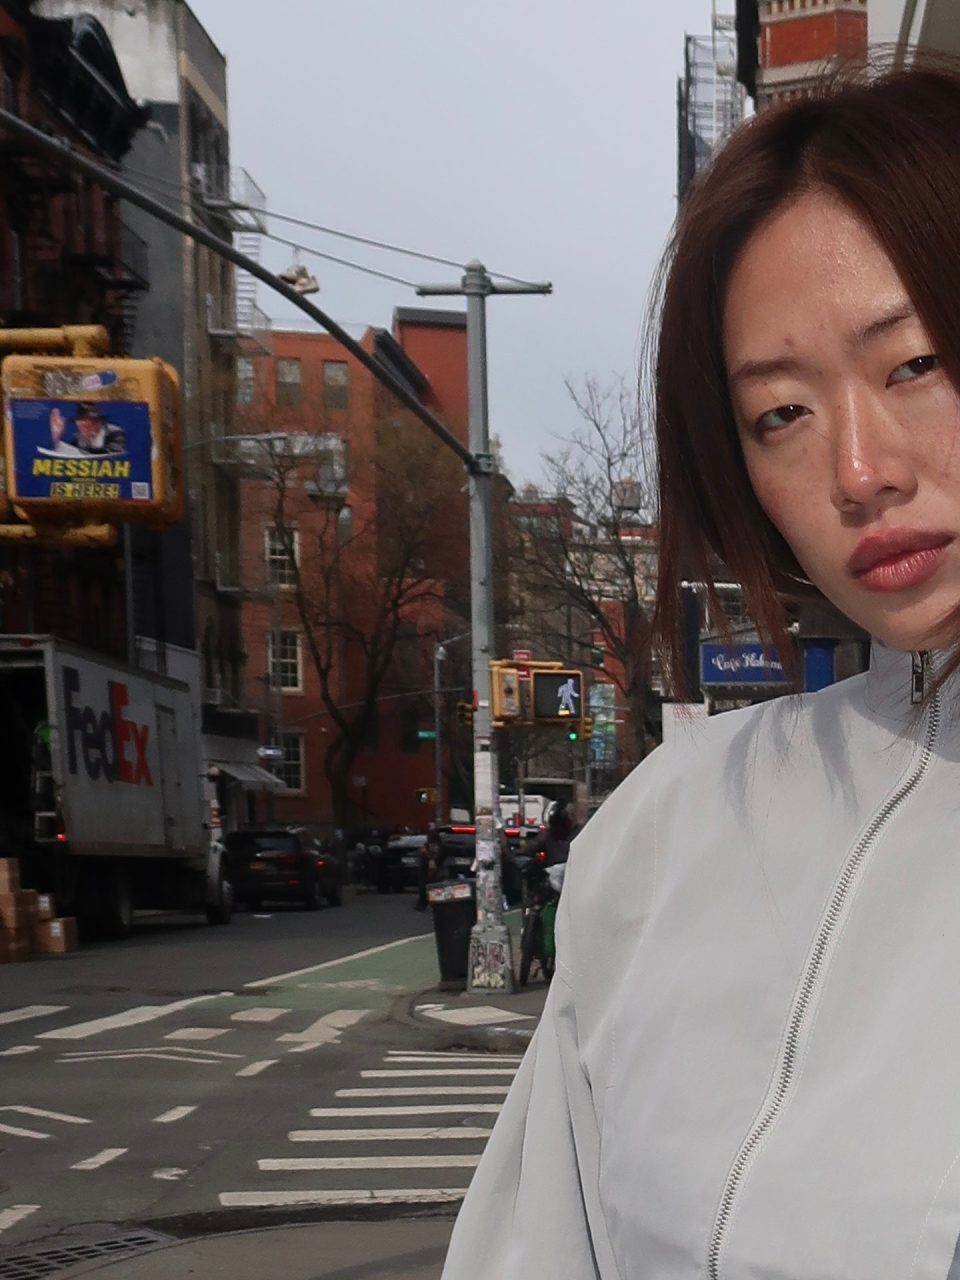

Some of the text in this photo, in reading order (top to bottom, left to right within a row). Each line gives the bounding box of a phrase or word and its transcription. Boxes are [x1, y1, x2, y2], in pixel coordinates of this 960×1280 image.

[32, 459, 130, 477] MESSIAH
[51, 482, 66, 498] IS
[62, 665, 153, 786] FedEx
